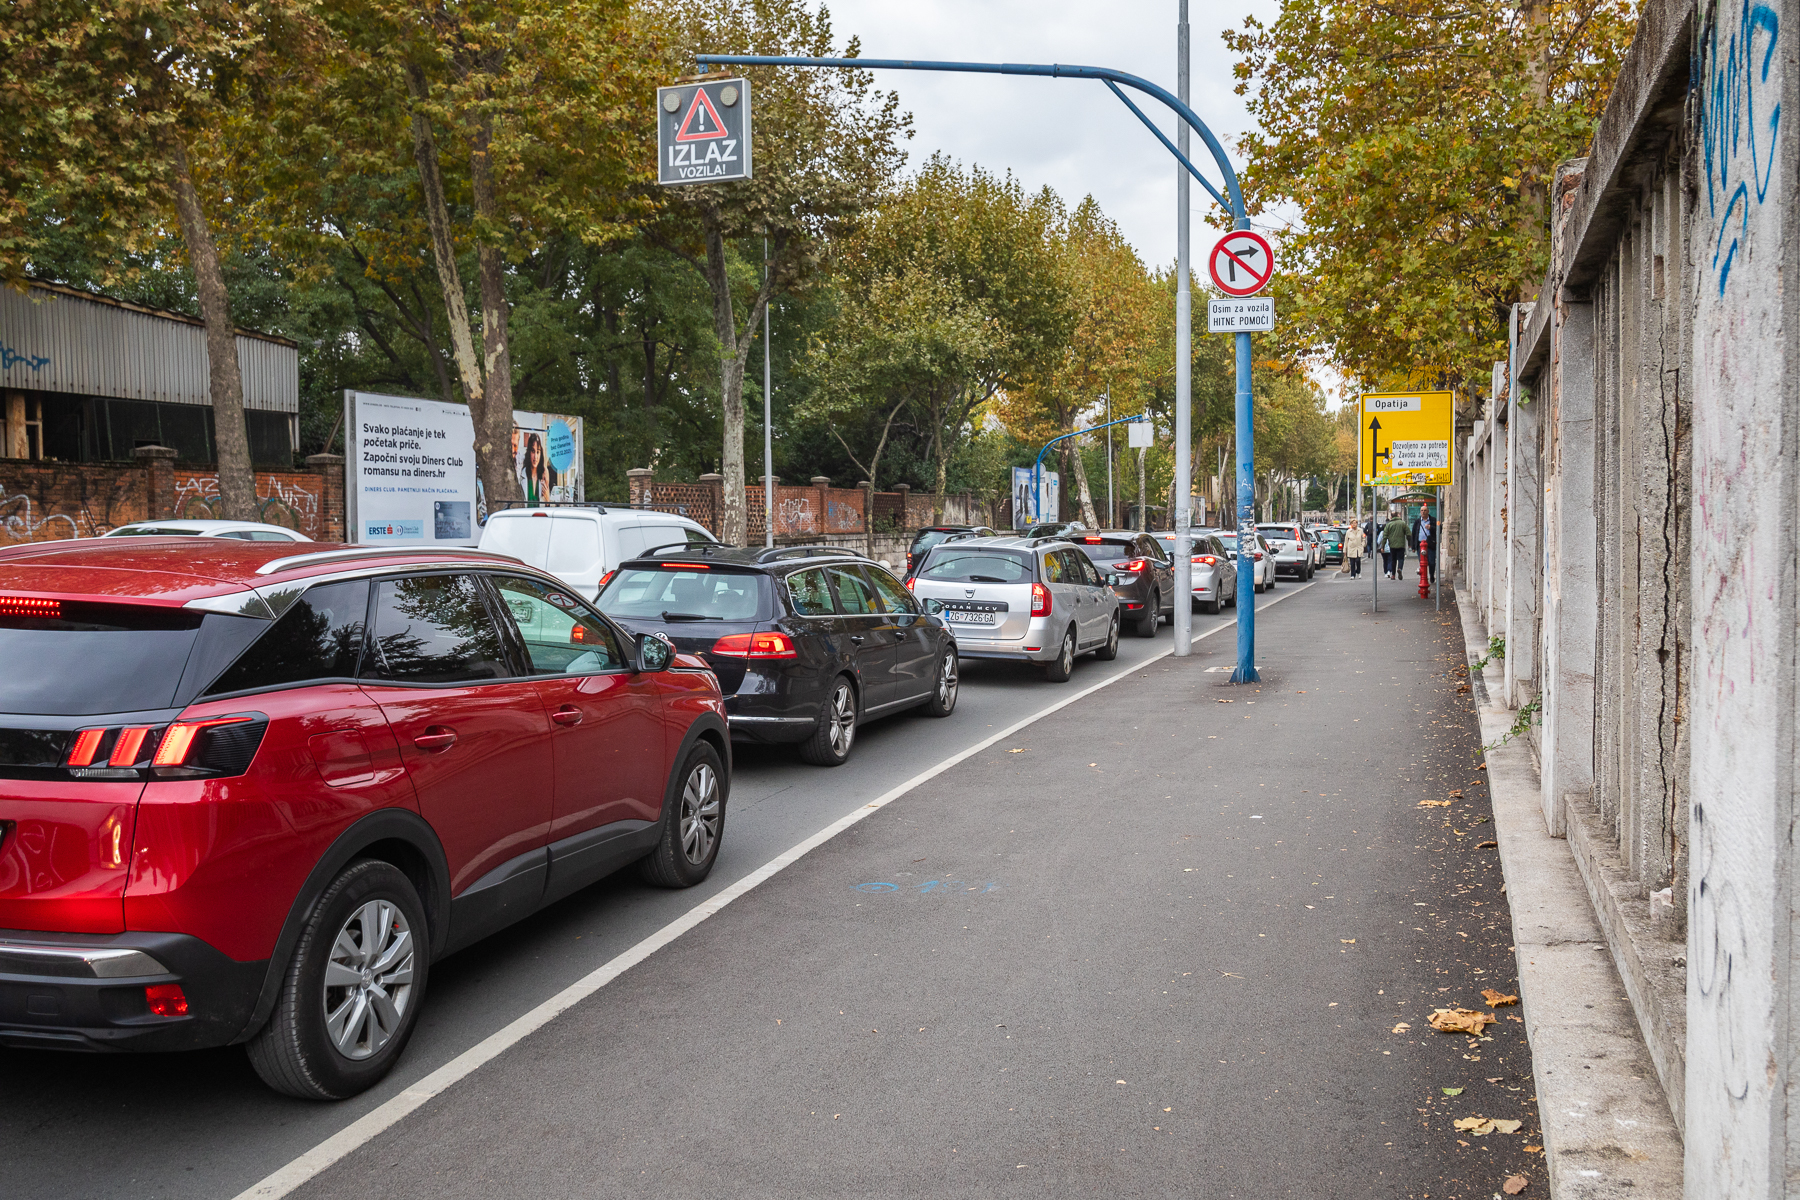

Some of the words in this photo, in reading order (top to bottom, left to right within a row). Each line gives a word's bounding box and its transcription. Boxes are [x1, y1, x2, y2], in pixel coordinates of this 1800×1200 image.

[668, 139, 738, 167] IZLAZ
[679, 164, 726, 178] VOZILA!
[1212, 304, 1231, 313] Osim
[1234, 305, 1244, 313] za
[1247, 302, 1270, 312] vozila
[1213, 316, 1236, 326] HITNE
[1239, 313, 1269, 326] POMOĆI
[1375, 399, 1408, 410] Opatija
[363, 423, 390, 435] Svako
[391, 426, 424, 439] plaćanje
[425, 428, 432, 439] je
[433, 429, 446, 439] tek
[363, 437, 398, 448] početak
[399, 439, 422, 451] priče.
[1392, 441, 1419, 451] Dozvoljeno
[1428, 441, 1448, 451] potrebe
[363, 451, 398, 463] Započni
[399, 454, 420, 466] svoju
[421, 455, 445, 466] Diners
[446, 457, 464, 467] Club
[1398, 450, 1416, 458] Zavoda
[1407, 459, 1433, 467] zdravstvo
[363, 467, 400, 476] romansu
[401, 469, 411, 477] na
[413, 467, 446, 478] diners.hr
[368, 526, 387, 535] ERSTE
[950, 612, 960, 620] ZG
